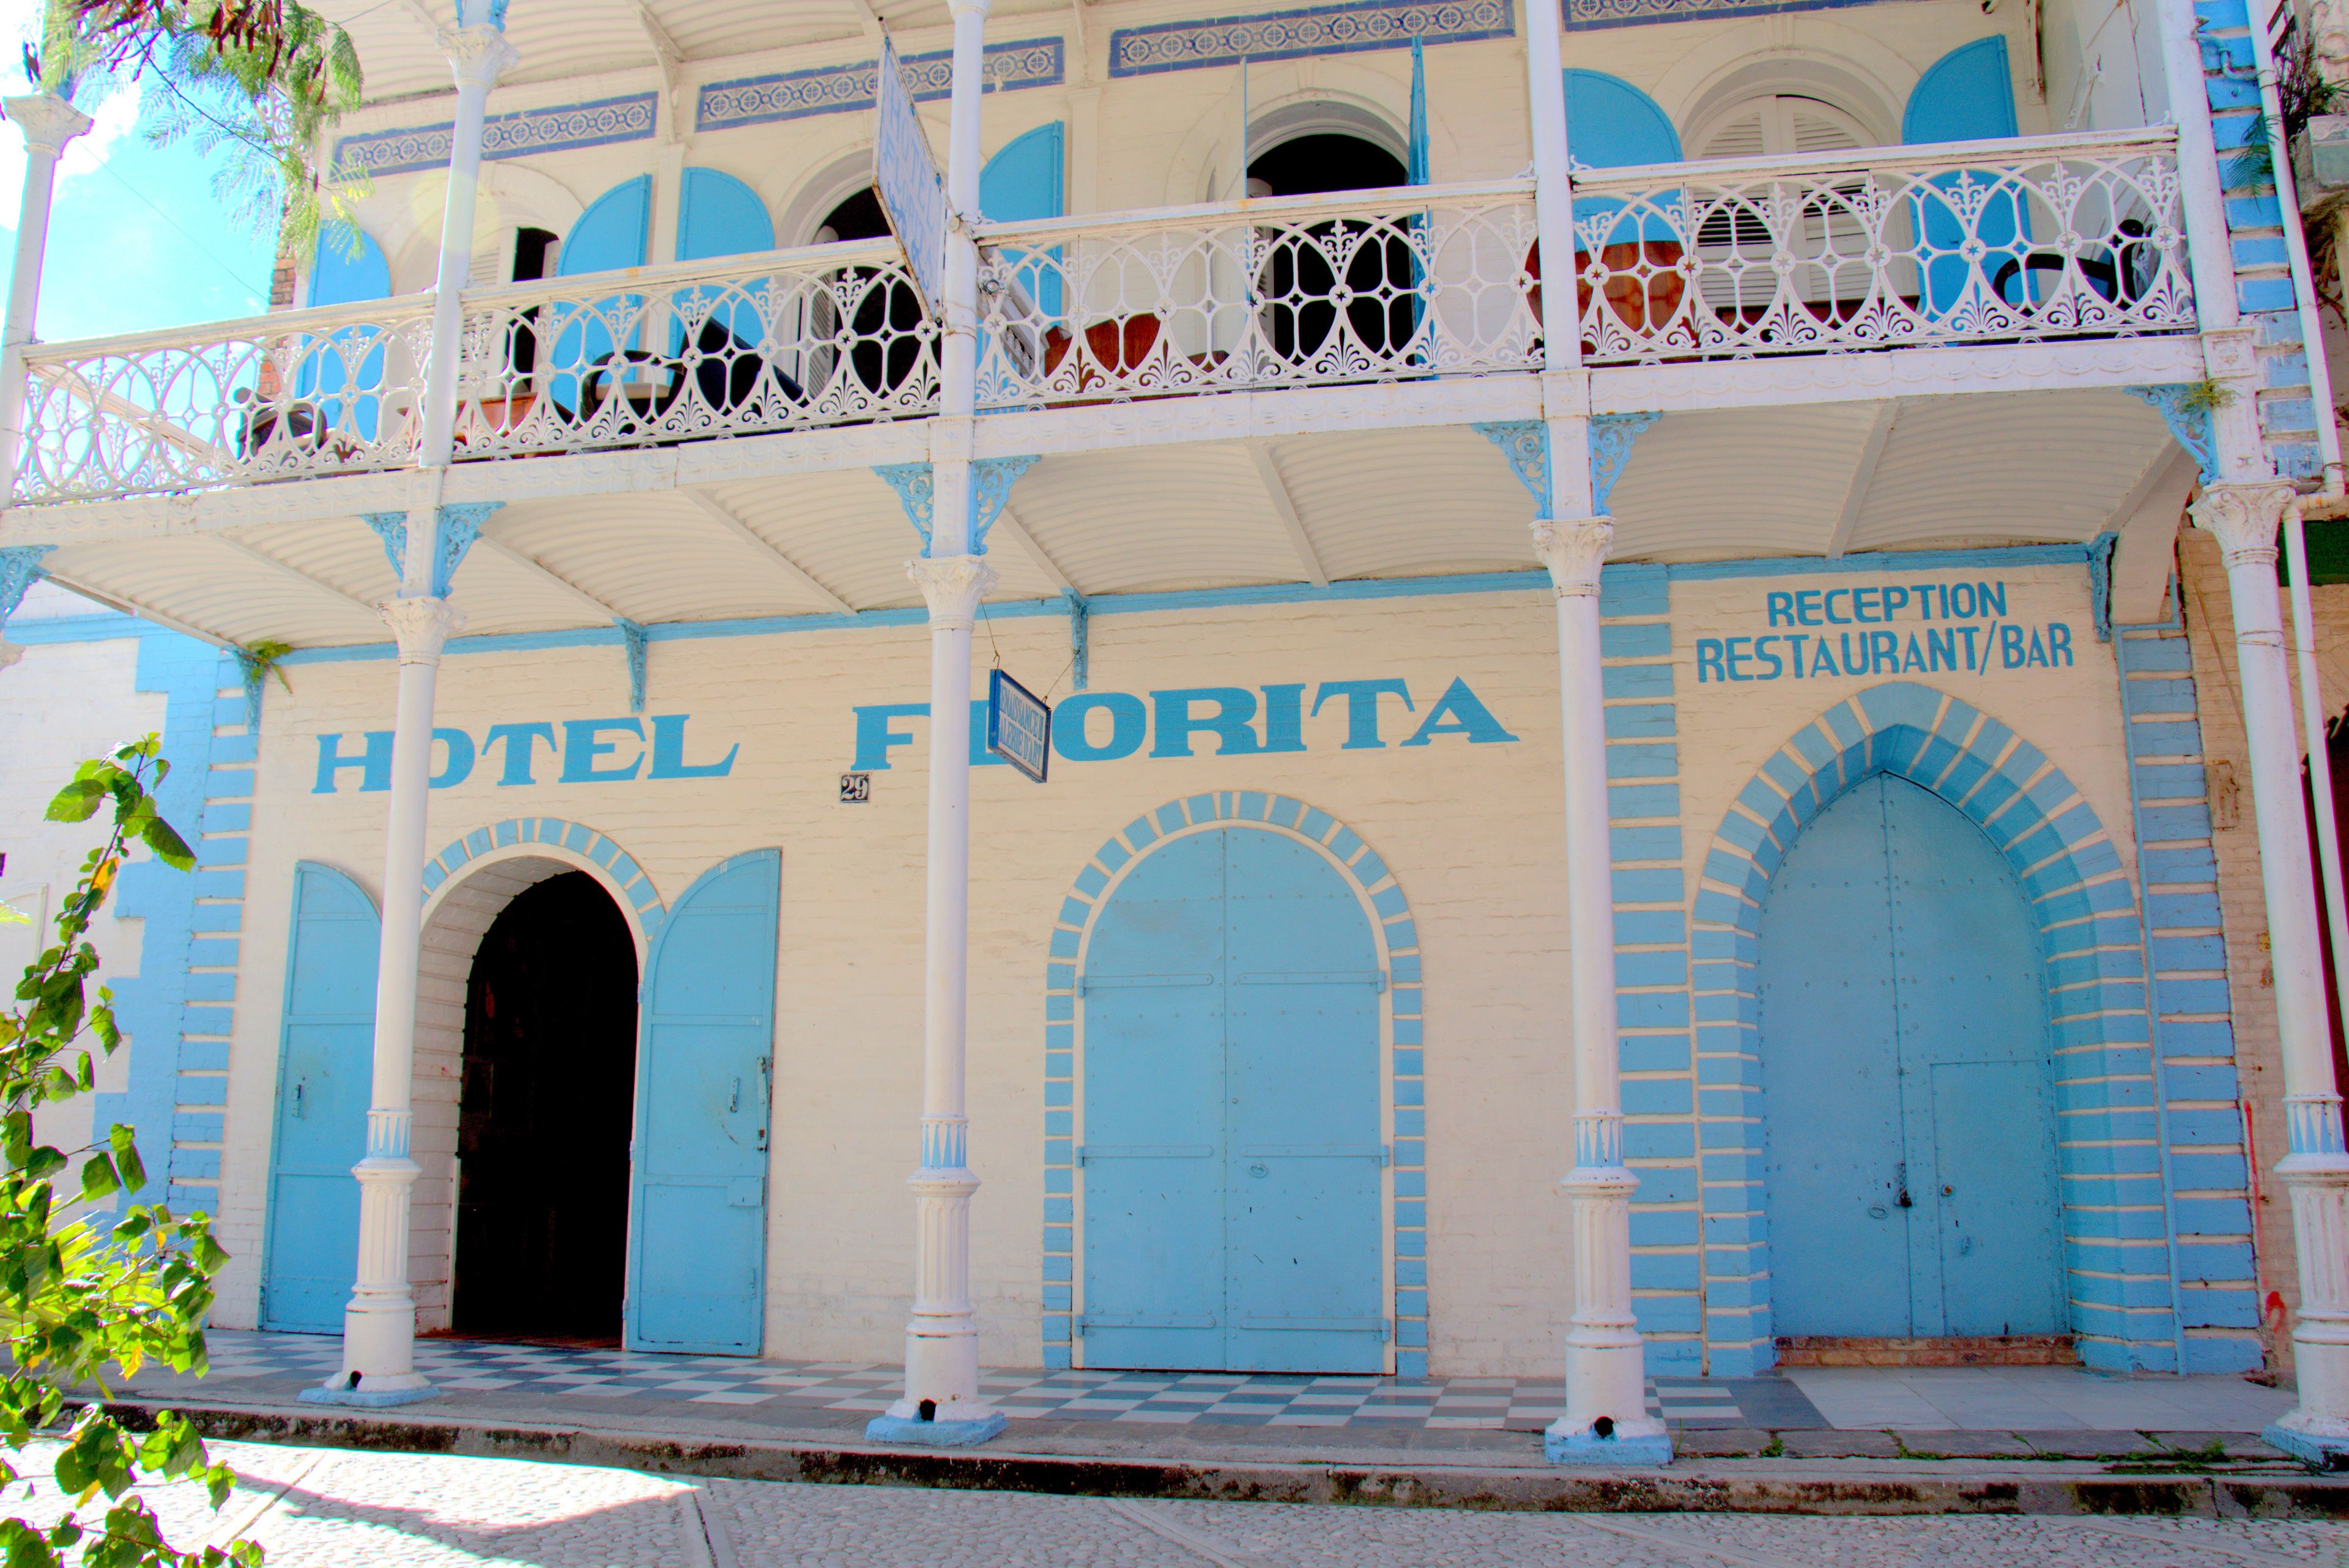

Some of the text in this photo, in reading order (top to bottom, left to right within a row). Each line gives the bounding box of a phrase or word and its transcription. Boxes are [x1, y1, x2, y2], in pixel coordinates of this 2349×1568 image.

[890, 83, 935, 233] HOTEL
[883, 132, 932, 278] FLORITA
[1767, 582, 2007, 627] RECEPTION
[1696, 620, 2074, 683] RESTAURANT/BAR
[998, 713, 1042, 770] ALERIE D'ART
[1000, 686, 1039, 738] ENAISSANCE
[311, 714, 740, 794] HOTEL
[841, 775, 868, 800] 29
